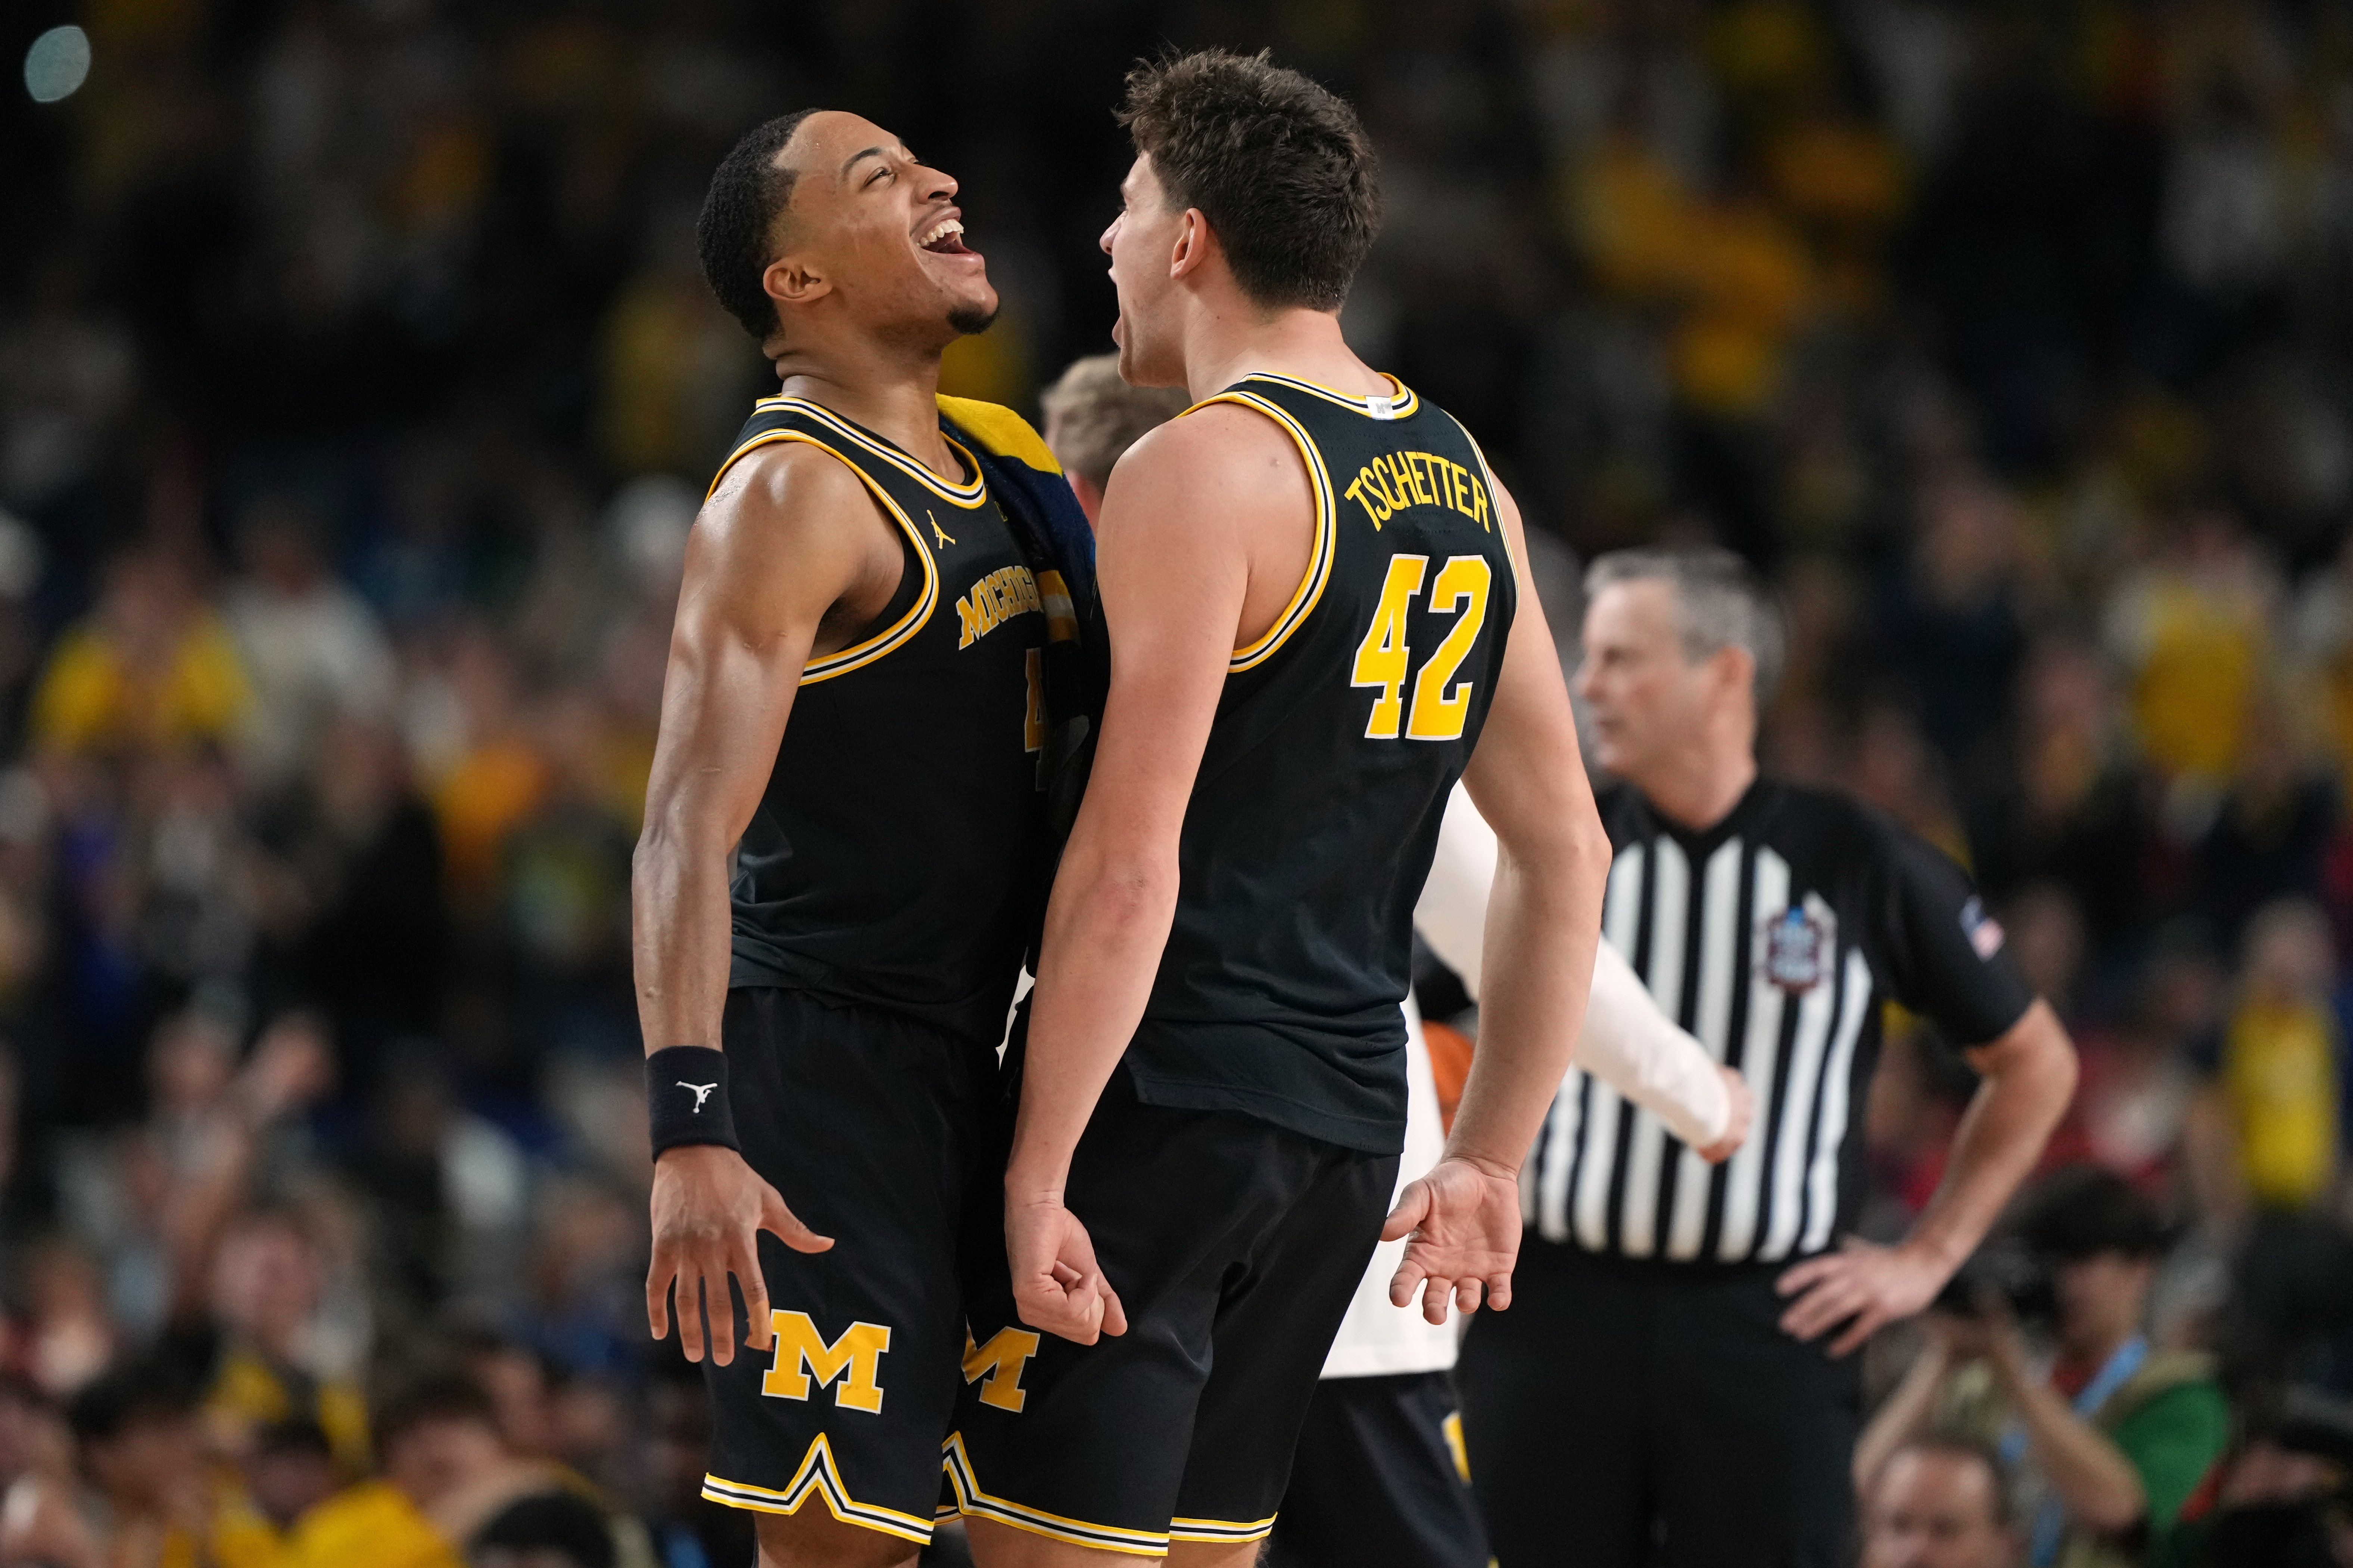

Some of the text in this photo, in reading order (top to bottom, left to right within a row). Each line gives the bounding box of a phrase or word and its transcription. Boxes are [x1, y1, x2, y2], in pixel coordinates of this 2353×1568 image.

[1344, 451, 1490, 533] TSCHETTER
[956, 565, 1044, 650] MICHIG
[1350, 554, 1491, 740] 42
[761, 1309, 891, 1414] M
